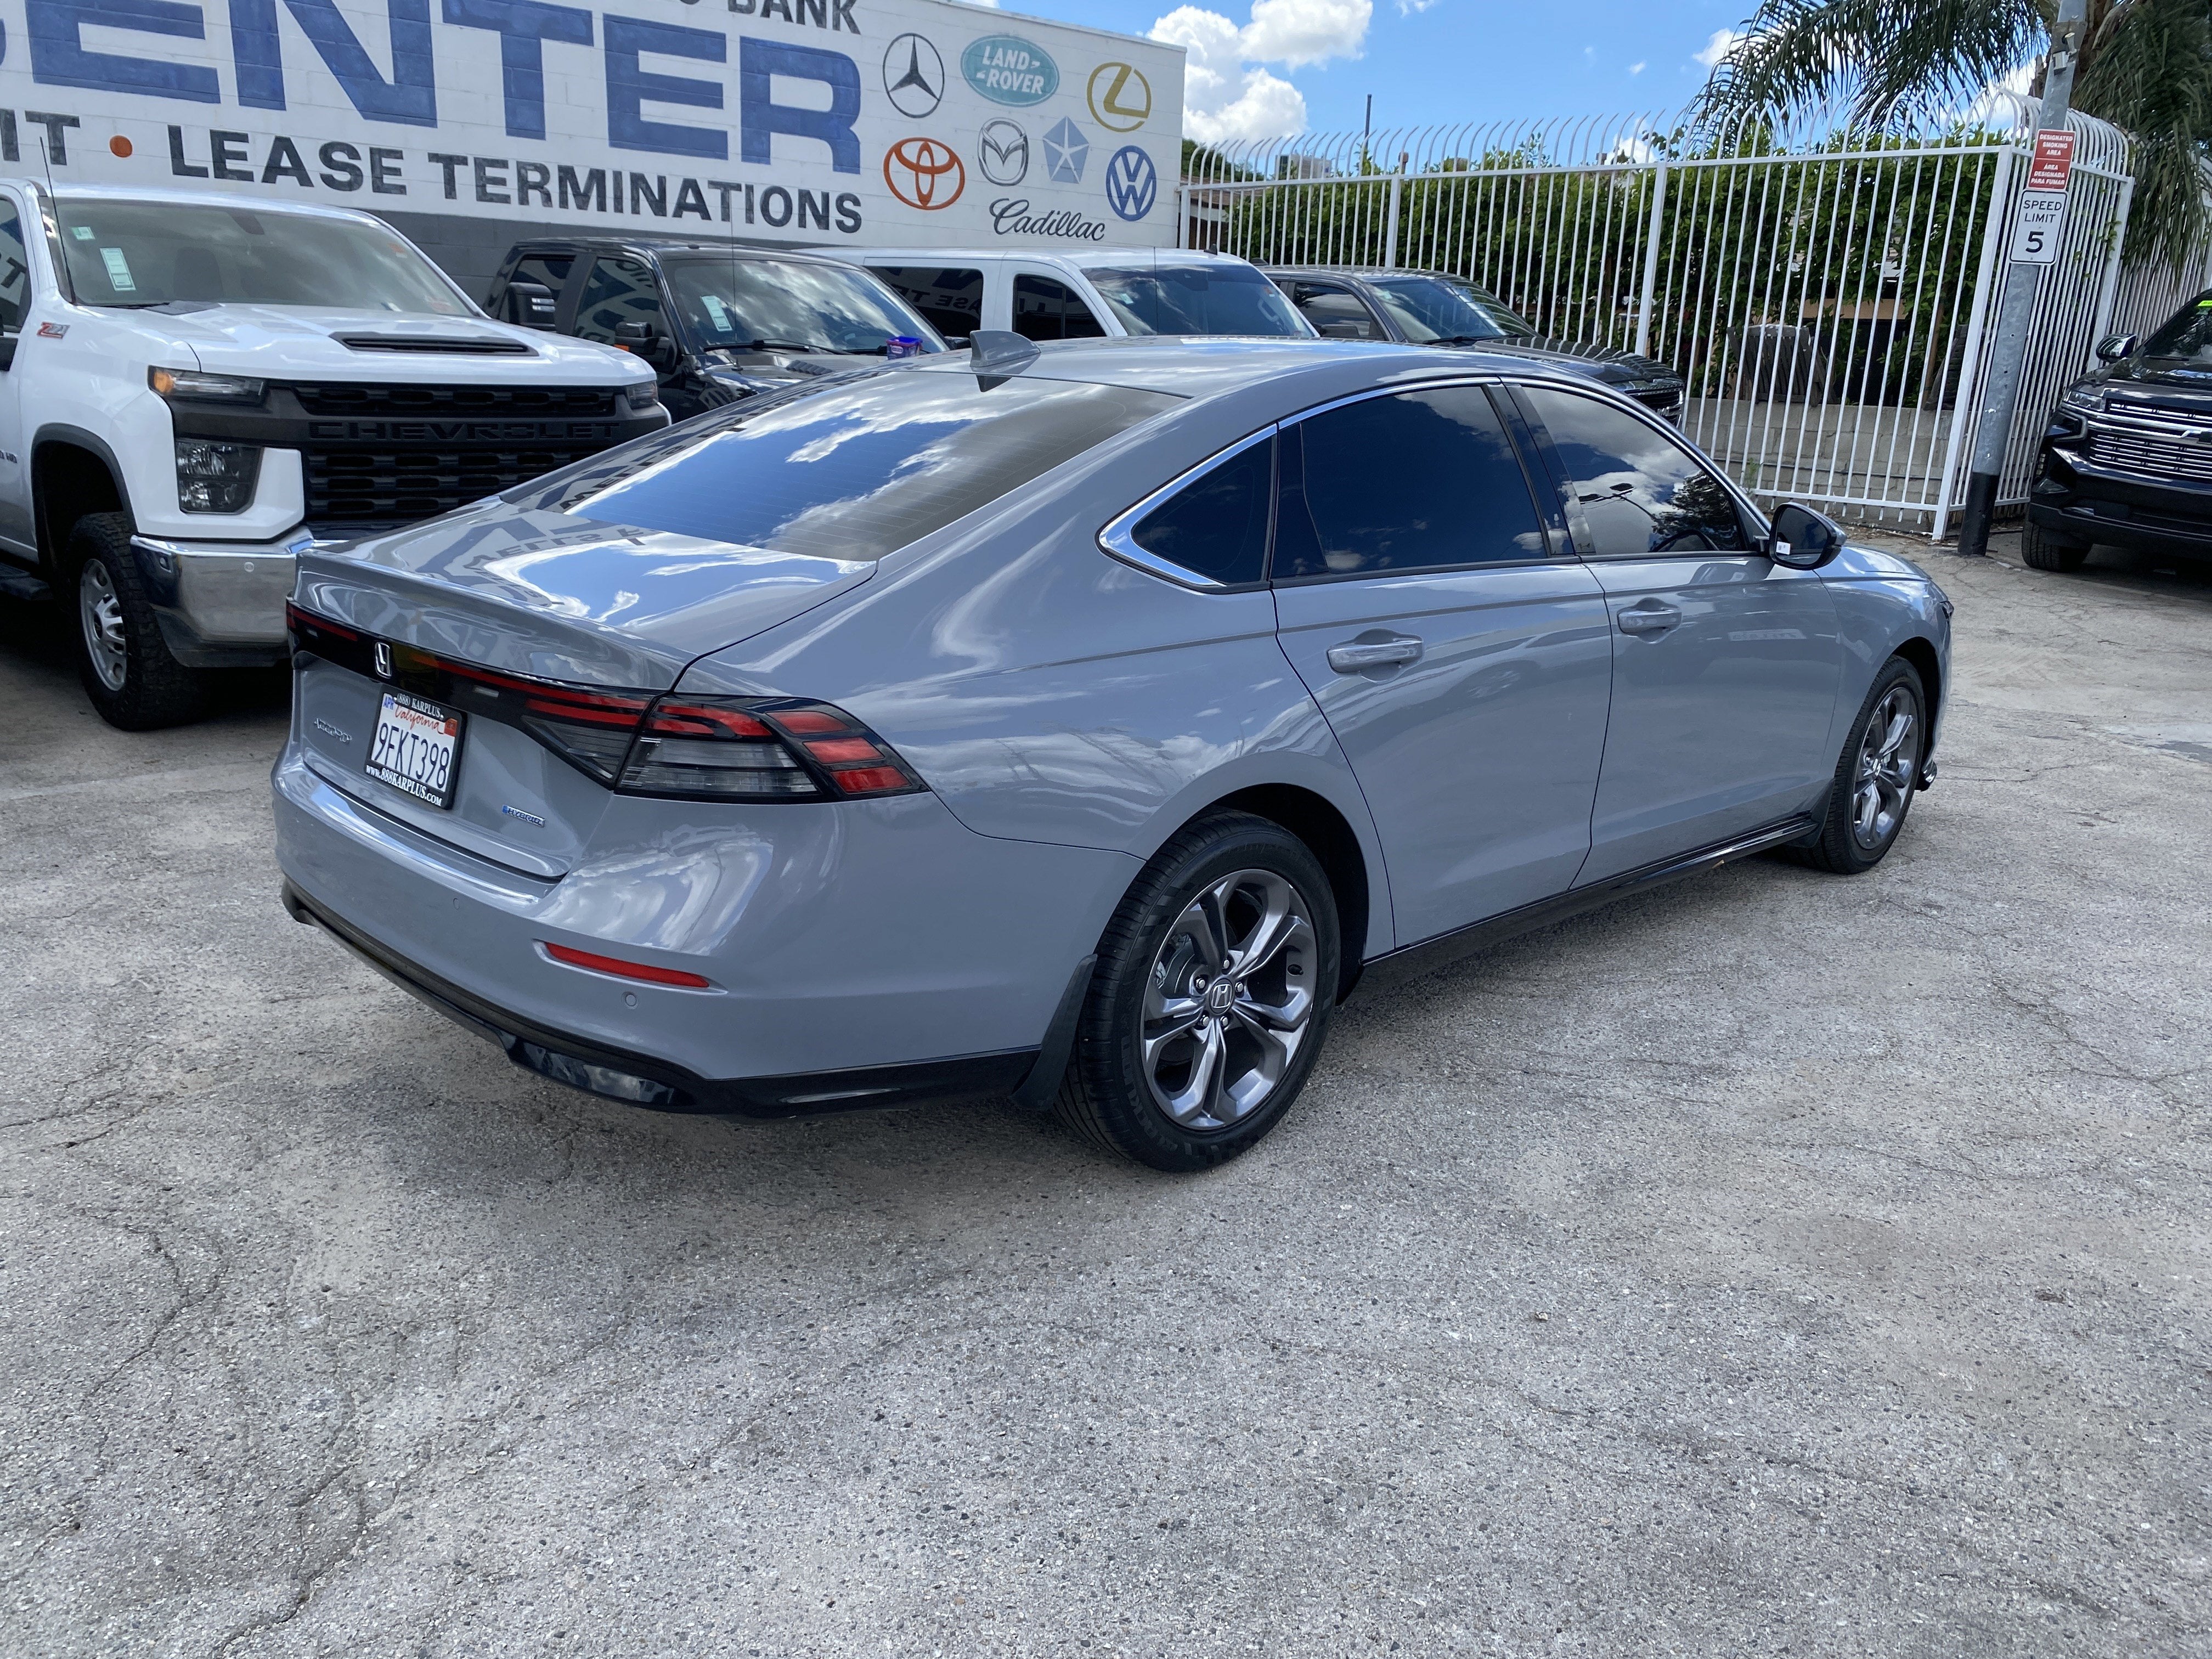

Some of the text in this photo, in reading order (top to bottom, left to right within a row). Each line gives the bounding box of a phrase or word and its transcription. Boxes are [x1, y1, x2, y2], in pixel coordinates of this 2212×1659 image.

[982, 46, 1029, 70] LAND
[0, 0, 861, 174] ENTER
[986, 68, 1045, 94] ROVER
[167, 123, 407, 196] LEASE
[428, 152, 862, 234] TERMINATIONS
[2023, 200, 2062, 211] SPEED
[2024, 212, 2056, 223] LIMIT
[989, 198, 1105, 241] Cadillac
[2025, 231, 2045, 253] 5
[308, 421, 621, 440] CHEVROLET
[397, 693, 441, 718] (888) KARPLUS
[394, 704, 444, 735] California
[374, 722, 450, 789] 9FKT398
[507, 808, 543, 826] HYBRID
